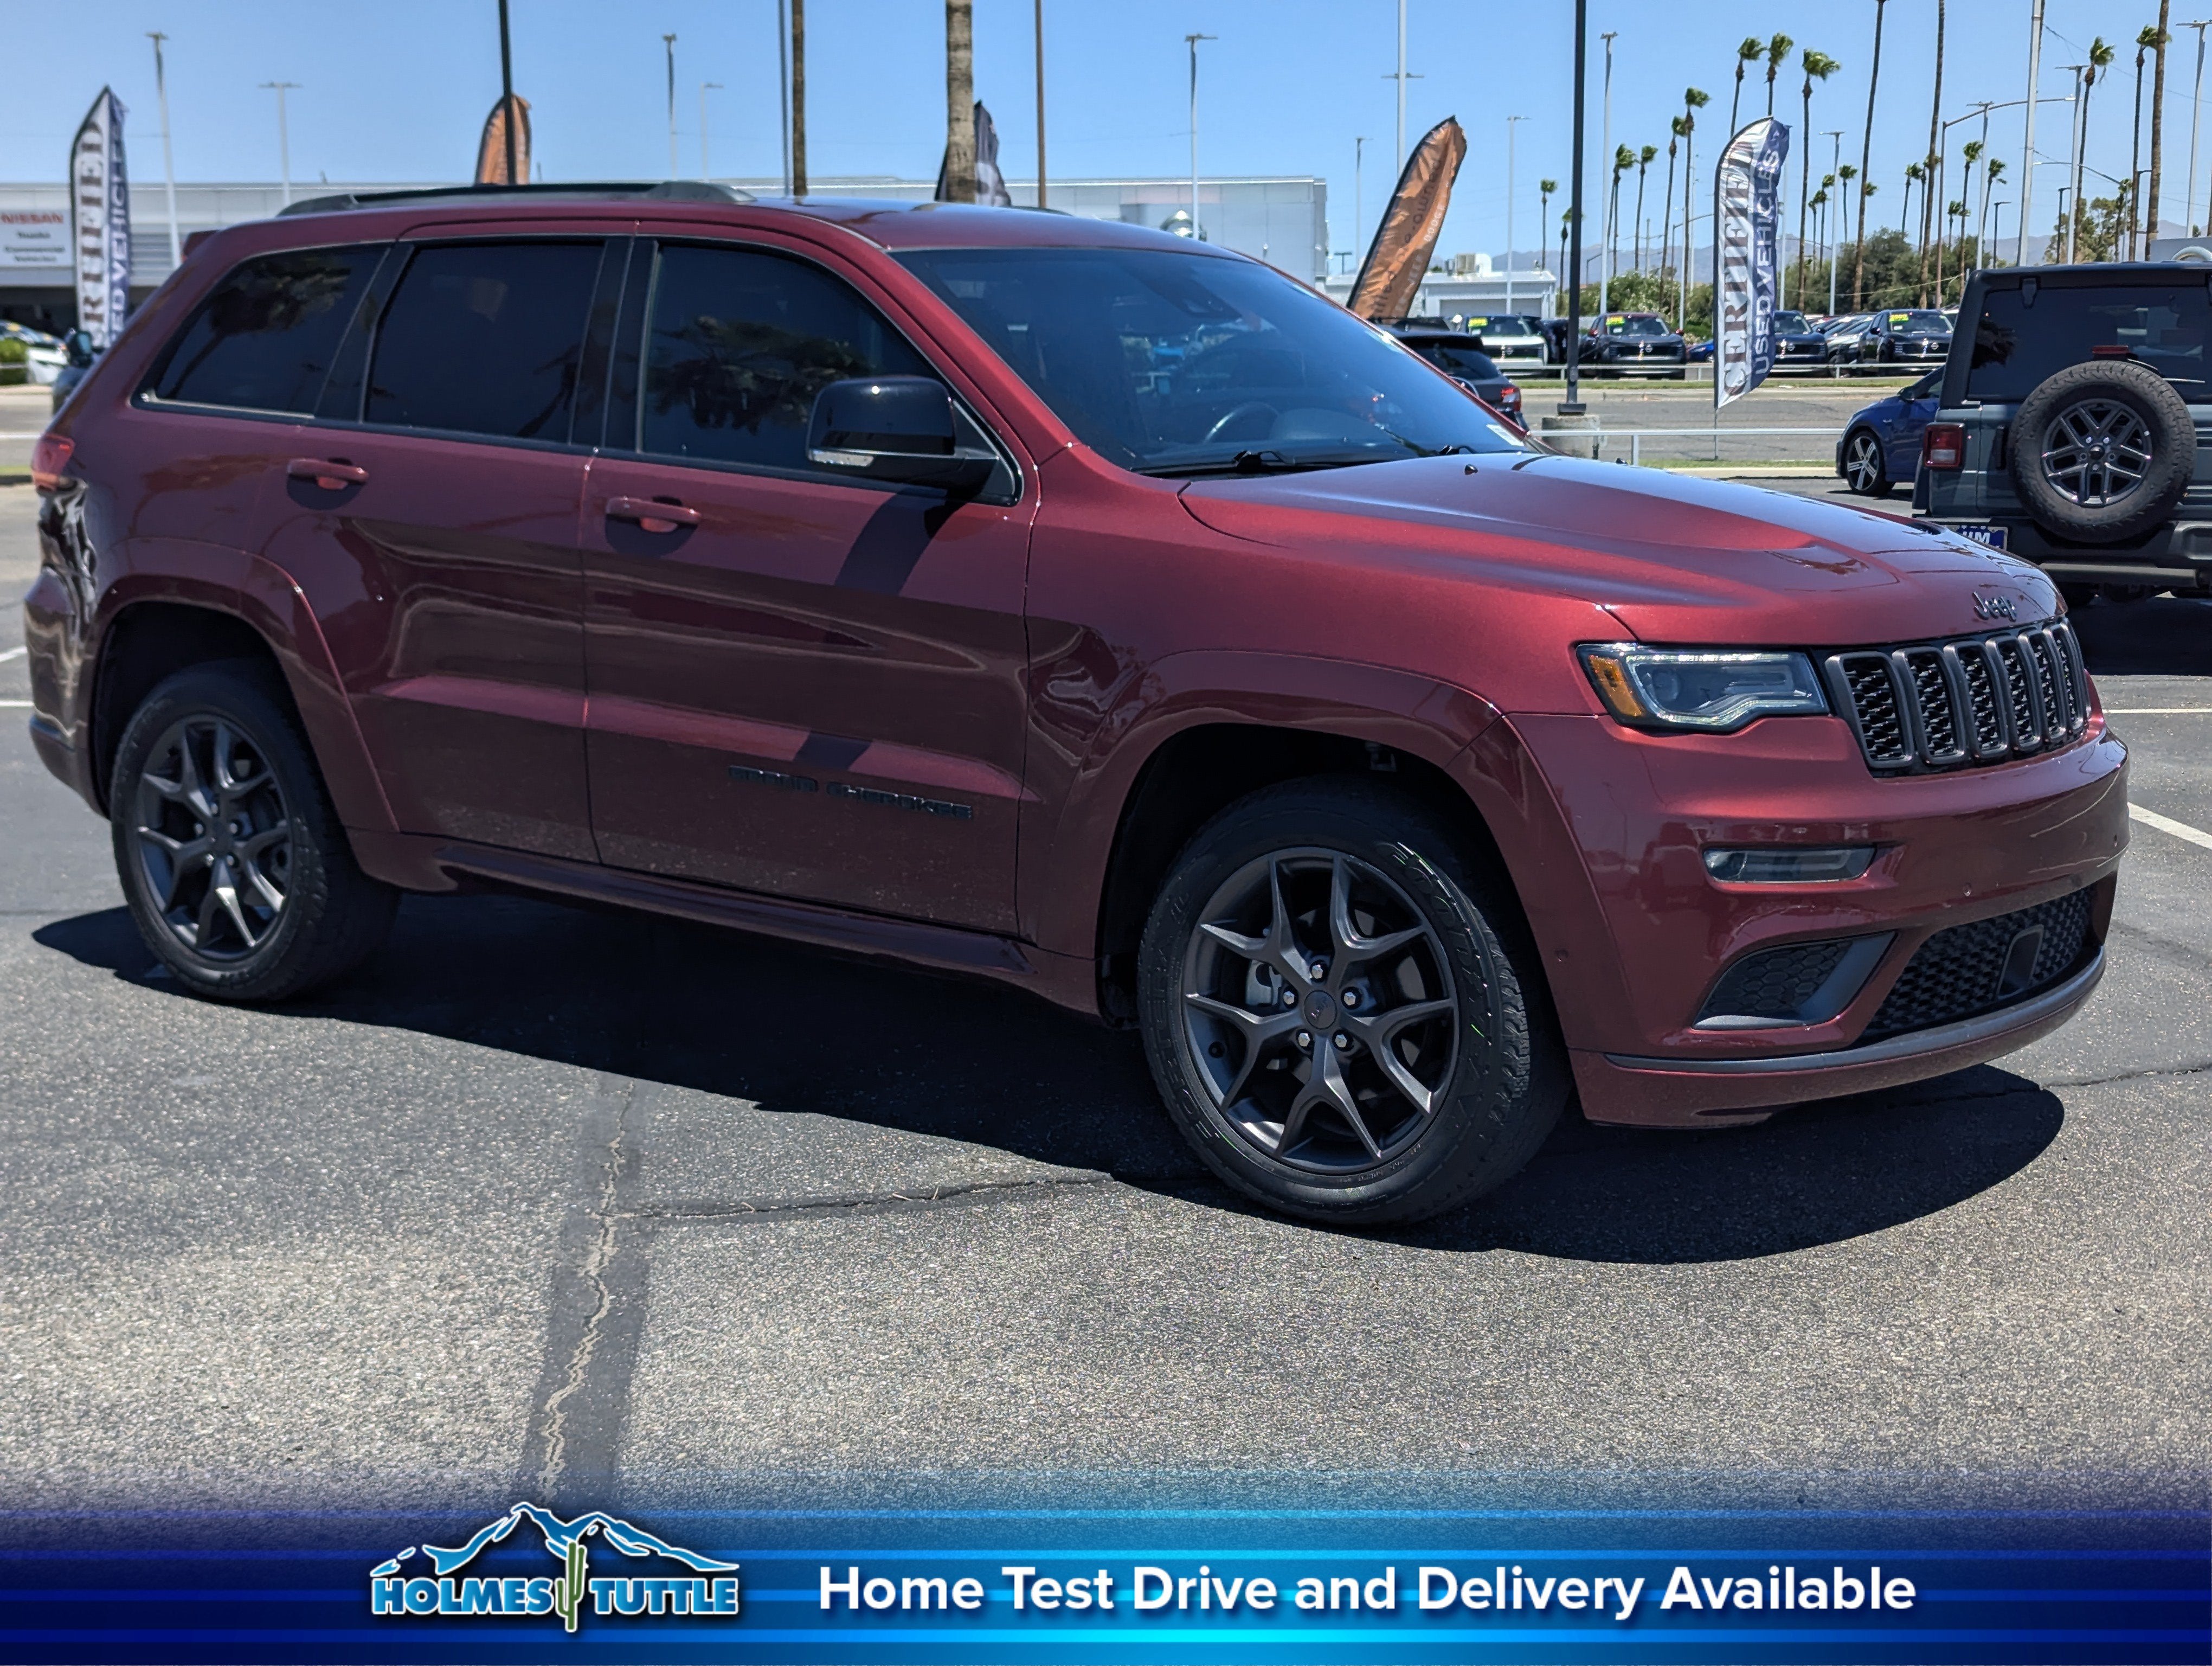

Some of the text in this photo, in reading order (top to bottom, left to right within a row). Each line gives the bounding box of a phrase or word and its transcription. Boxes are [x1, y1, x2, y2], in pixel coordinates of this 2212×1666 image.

[1, 213, 64, 224] NISSAN
[1724, 141, 1753, 395] CERTIFIED
[1754, 148, 1780, 375] USED VEHICLES
[1972, 592, 2016, 622] Jeep
